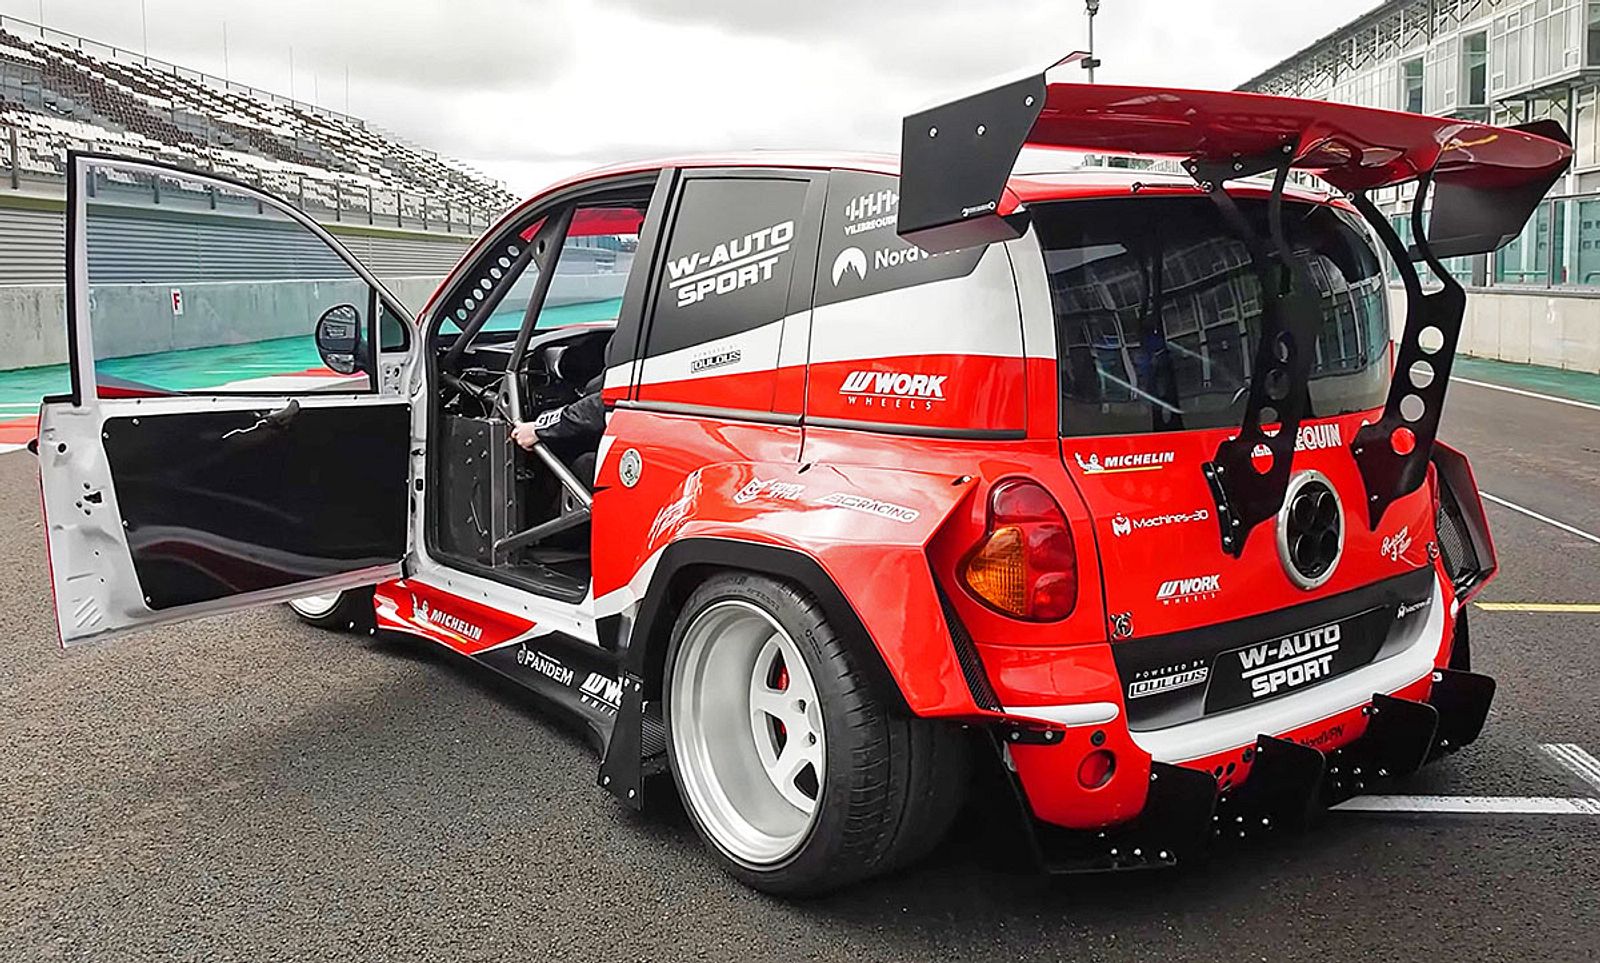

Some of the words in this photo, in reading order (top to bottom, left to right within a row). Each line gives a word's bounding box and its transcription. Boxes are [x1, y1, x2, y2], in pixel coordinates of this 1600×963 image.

[667, 220, 794, 280] W-AUTO
[677, 256, 779, 308] SPORT
[173, 292, 180, 311] F
[873, 371, 948, 397] WORK
[848, 396, 932, 411] WHEELS
[1104, 452, 1175, 468] MICHELIN
[1179, 574, 1220, 595] WORK
[430, 608, 483, 641] MICHELIN
[1238, 624, 1341, 670] W-AUTO
[524, 650, 574, 687] PANDEM
[1252, 654, 1333, 698] SPORT
